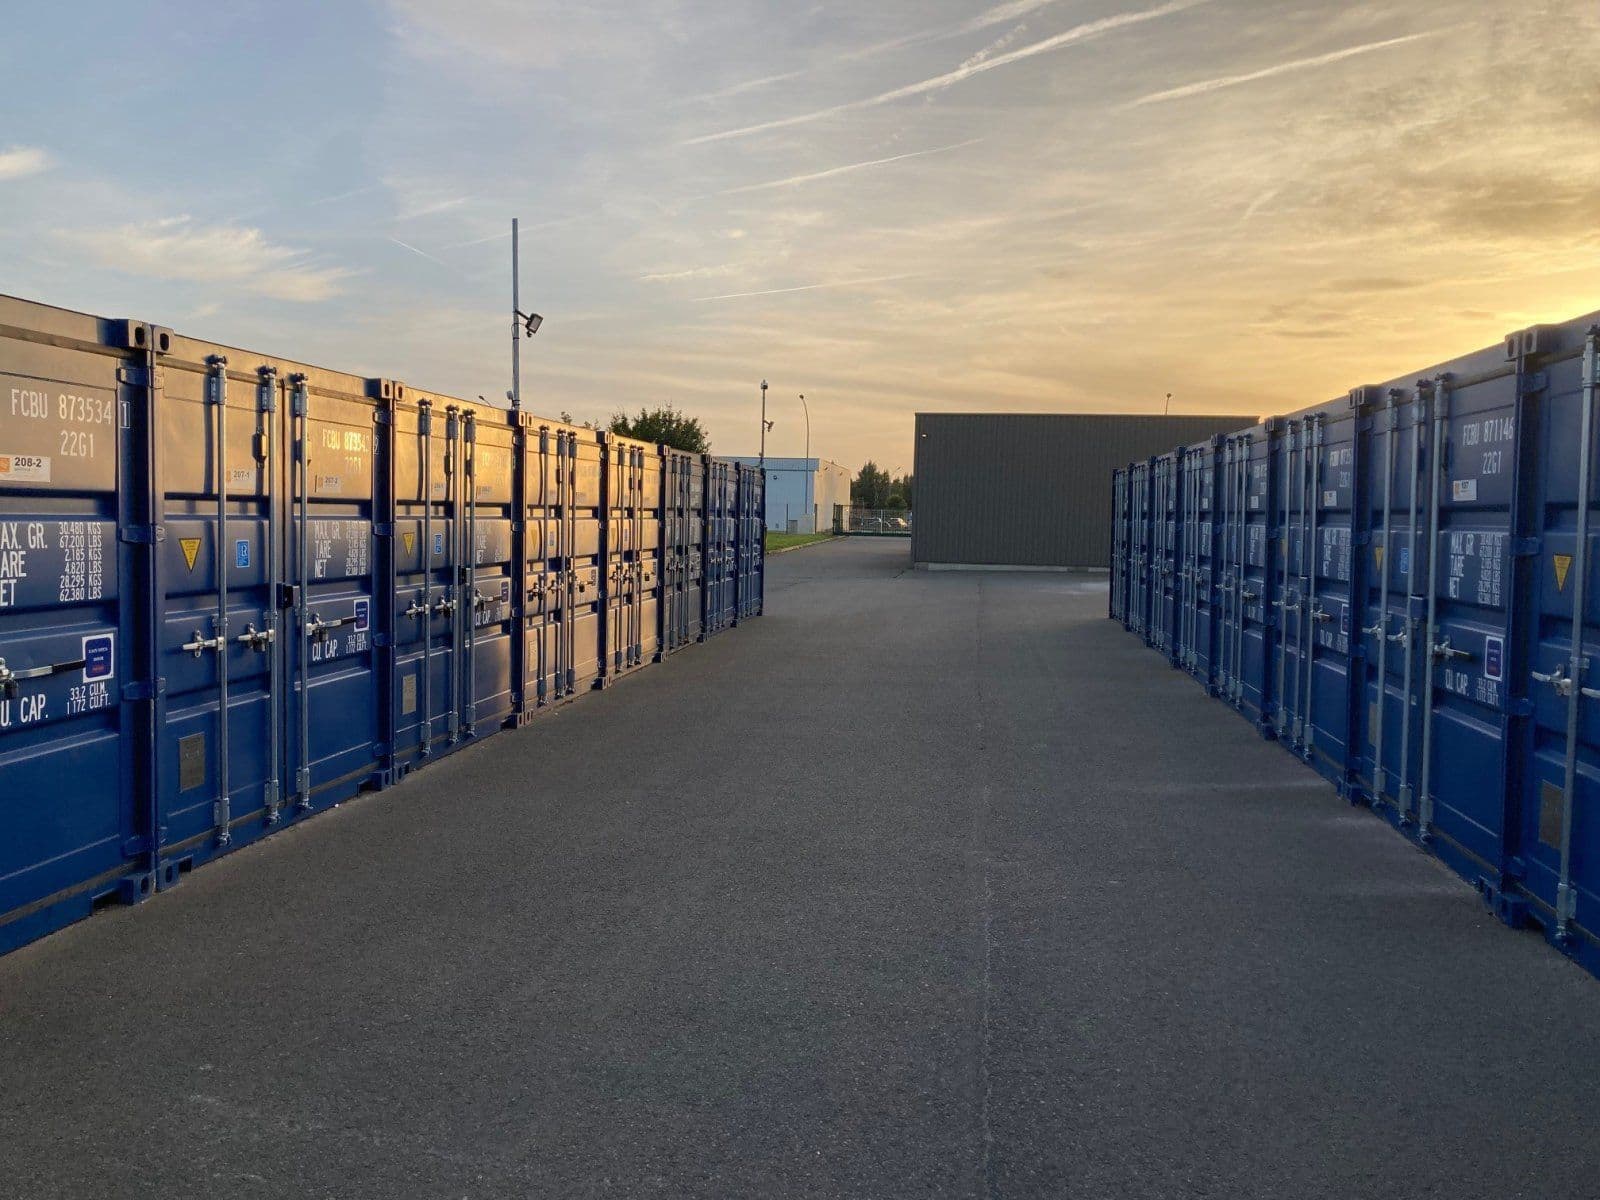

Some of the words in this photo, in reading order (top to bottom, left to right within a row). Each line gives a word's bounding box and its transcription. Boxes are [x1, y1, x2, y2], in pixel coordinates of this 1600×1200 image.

[11, 389, 48, 419] FCBU
[59, 394, 112, 425] 873534
[1483, 417, 1515, 443] 871146
[60, 430, 94, 458] 22G1
[14, 457, 42, 468] 208-2
[1482, 451, 1502, 475] 22G1
[27, 522, 48, 549] GR.
[87, 521, 102, 535] KGS
[88, 535, 102, 548] LBS
[88, 548, 102, 561] KGS
[88, 561, 102, 574] LBS
[314, 559, 327, 578] NET
[88, 573, 102, 587] KGS
[88, 586, 102, 600] LBS
[69, 685, 86, 701] 33.2
[20, 693, 48, 724] CAP.
